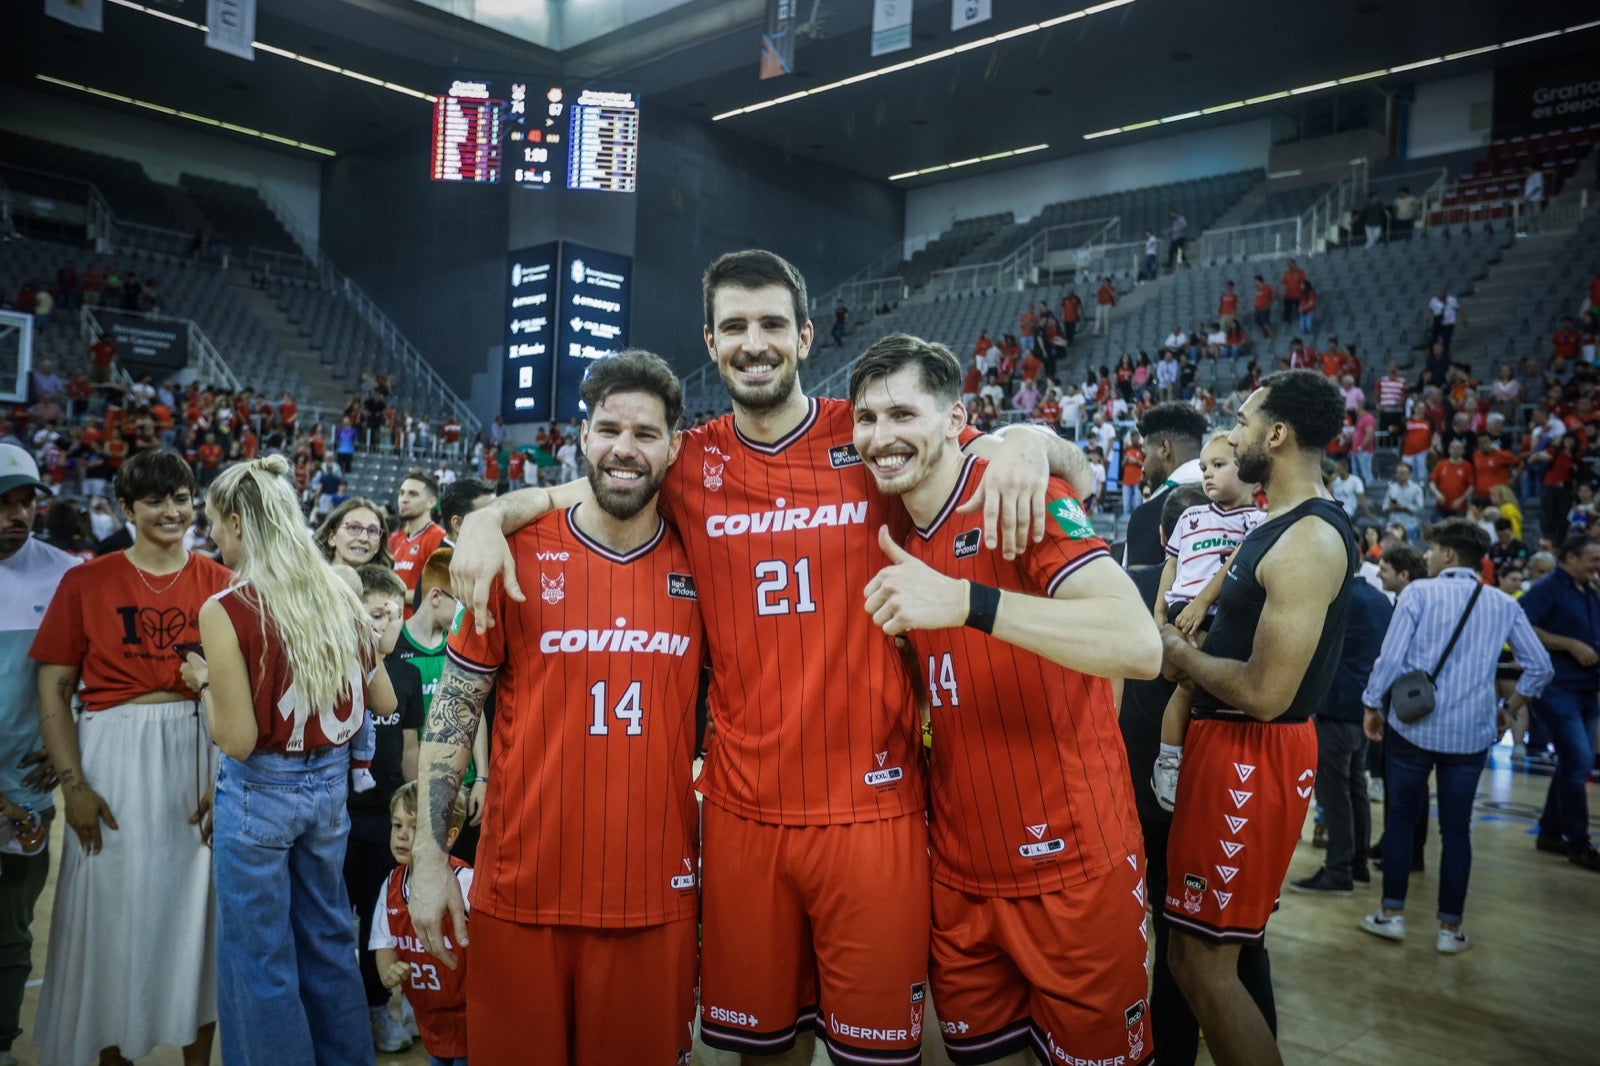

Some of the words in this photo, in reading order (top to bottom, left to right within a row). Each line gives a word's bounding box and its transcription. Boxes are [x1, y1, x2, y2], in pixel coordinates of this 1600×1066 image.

[536, 550, 570, 561] vive
[754, 556, 816, 617] 21
[116, 606, 142, 645] I
[589, 680, 643, 736] 14
[410, 962, 441, 991] 23
[840, 1023, 907, 1041] BERNER
[1128, 1012, 1142, 1025] acb
